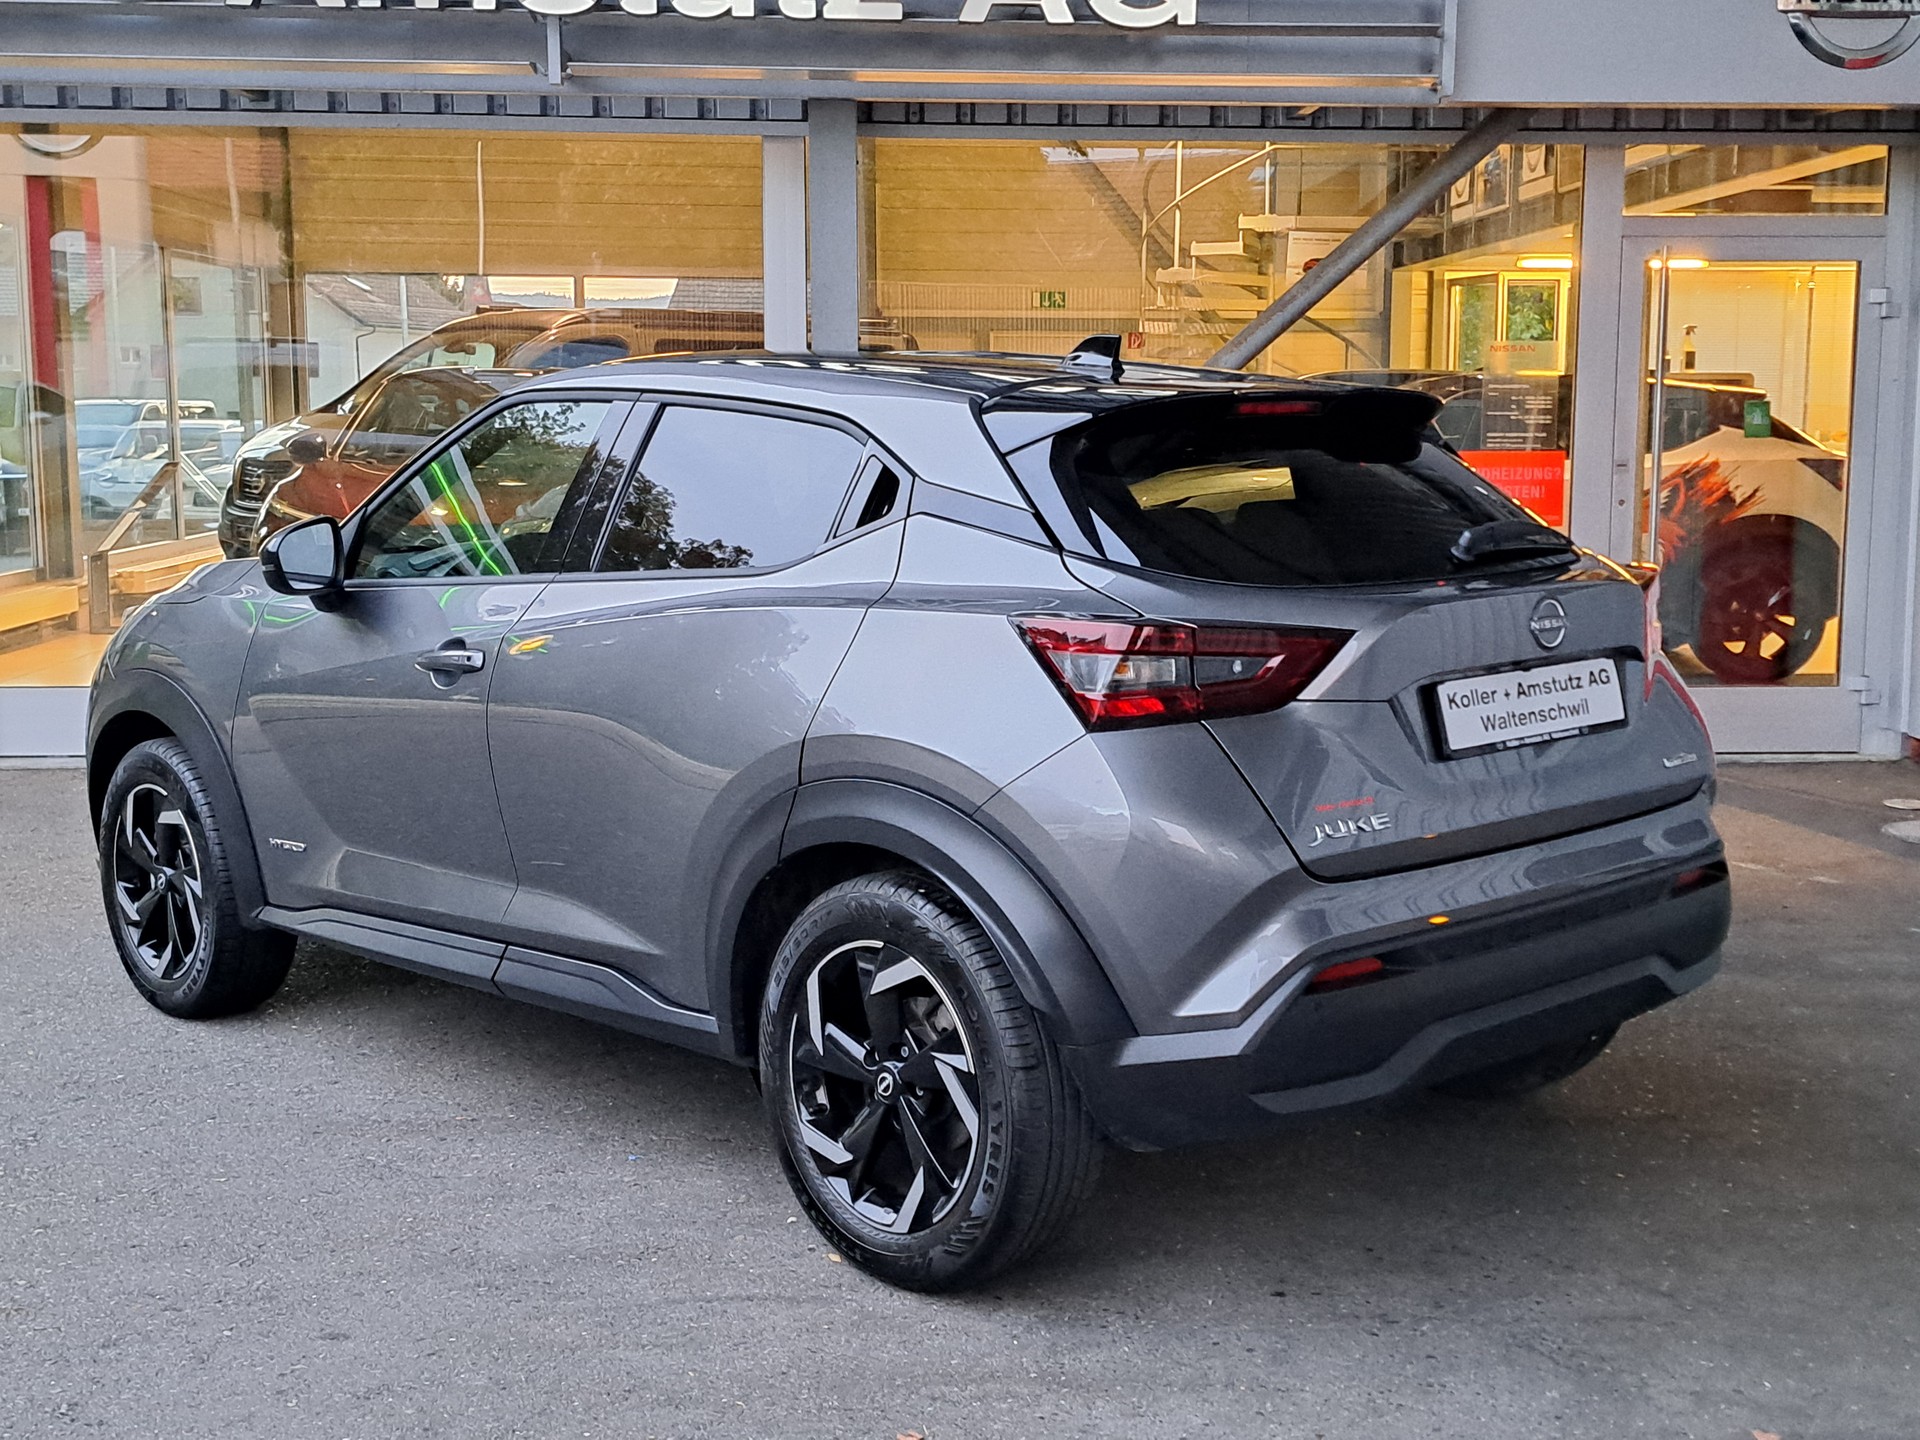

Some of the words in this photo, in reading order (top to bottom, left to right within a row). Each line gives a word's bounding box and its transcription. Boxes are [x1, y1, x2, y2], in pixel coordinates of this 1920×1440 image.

[1489, 344, 1536, 353] NISSAN
[1499, 485, 1546, 498] STEN!
[1446, 688, 1498, 710] Koller
[1504, 689, 1511, 700] +
[1516, 674, 1583, 699] Amstutz
[1588, 668, 1611, 687] AG
[1480, 698, 1590, 733] Waltenschwil
[1308, 812, 1392, 847] JUKE
